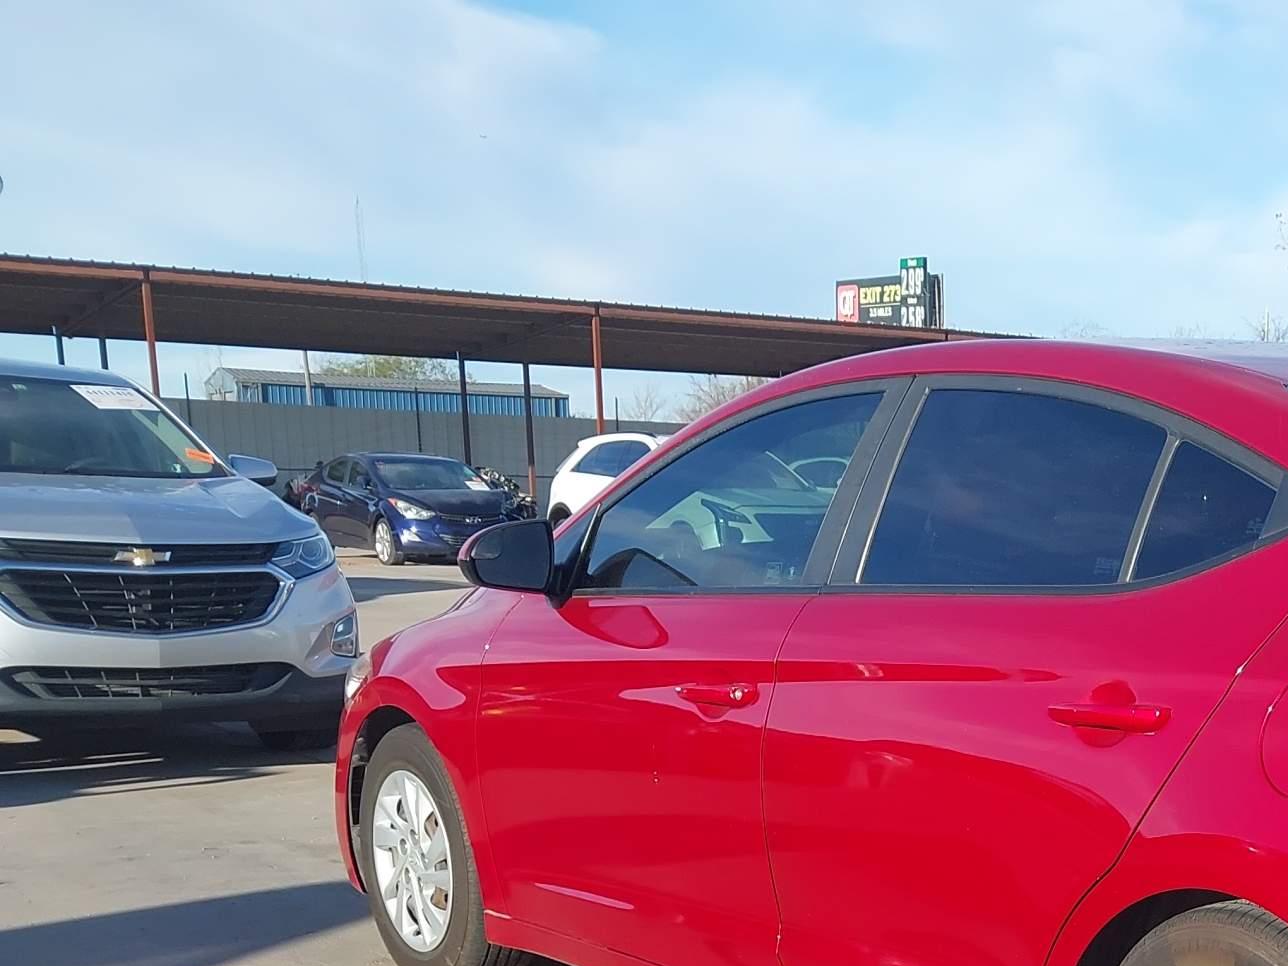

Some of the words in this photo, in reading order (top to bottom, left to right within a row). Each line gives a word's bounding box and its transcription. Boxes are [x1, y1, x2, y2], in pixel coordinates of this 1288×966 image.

[840, 290, 856, 319] QT
[860, 287, 882, 304] EXIT
[883, 284, 901, 302] 273
